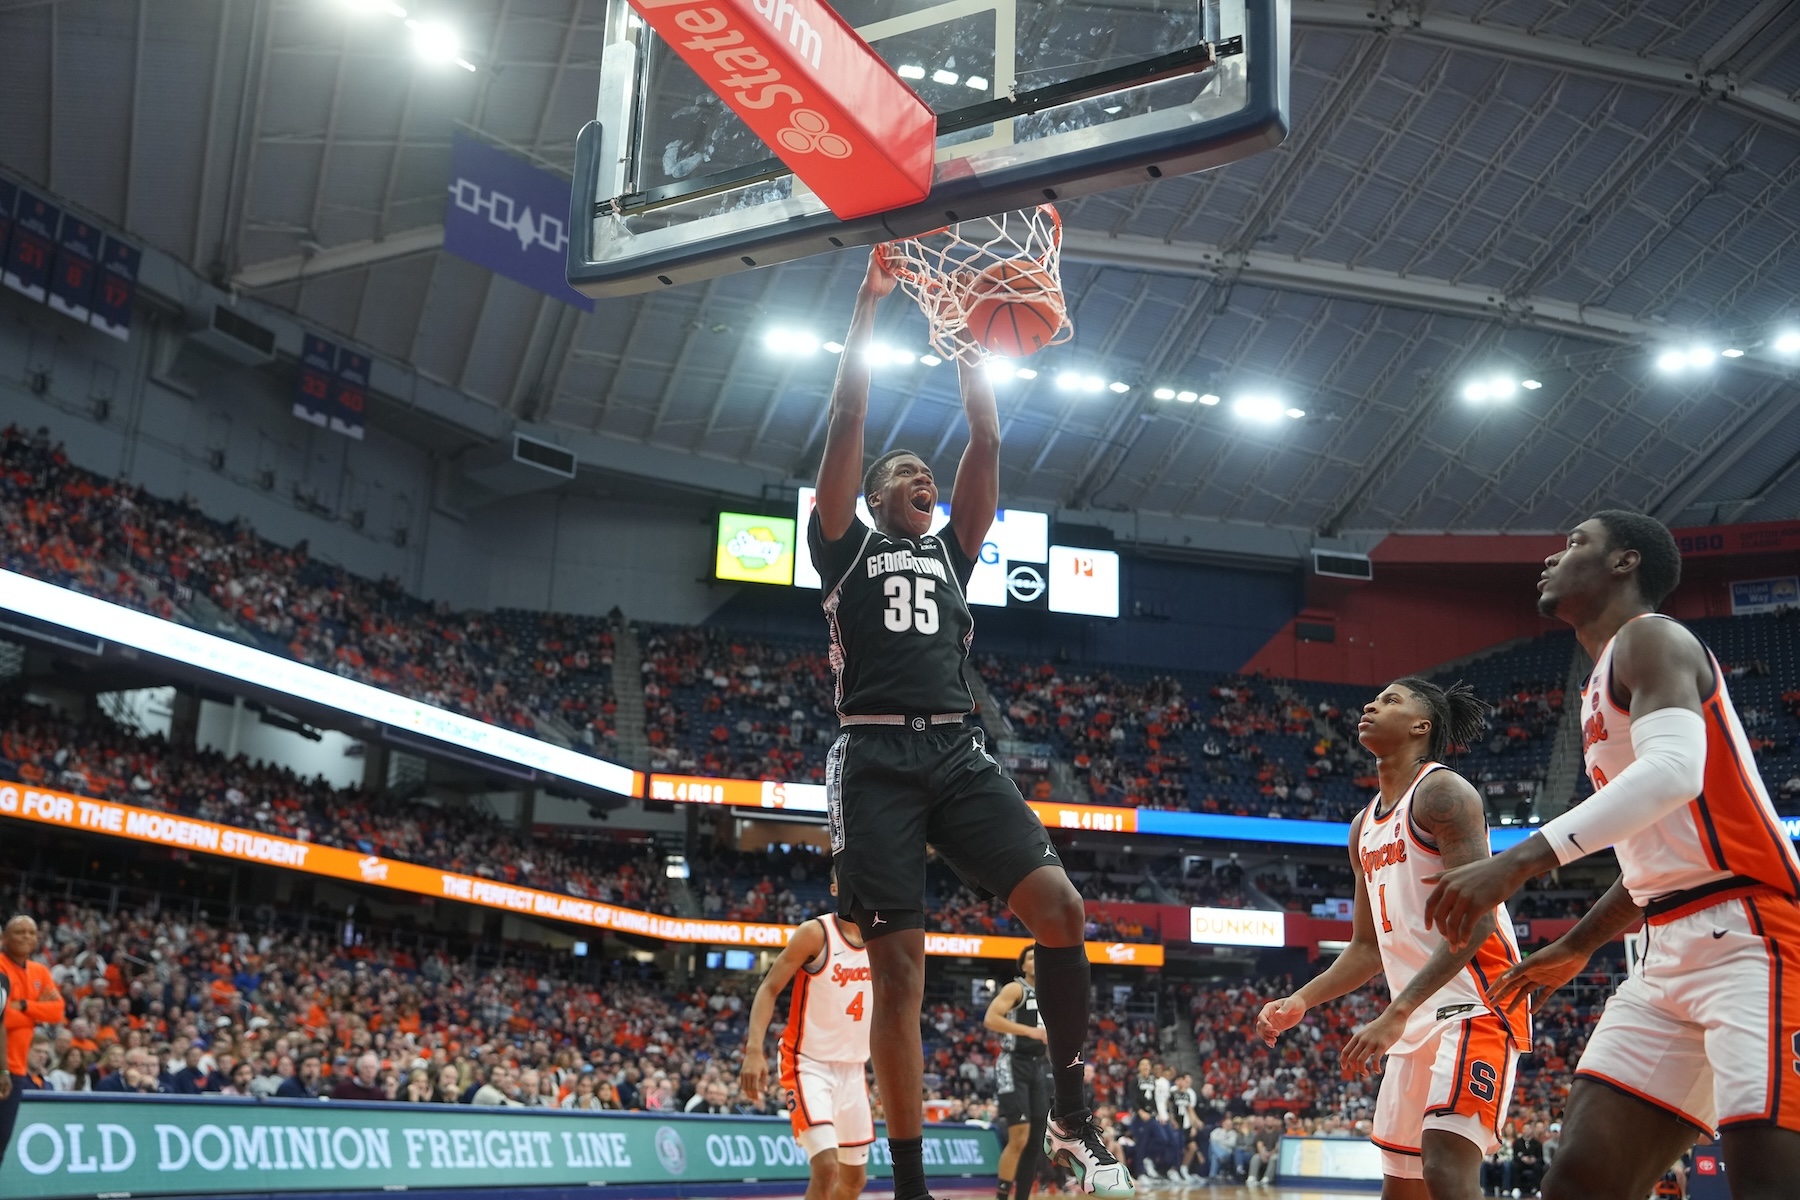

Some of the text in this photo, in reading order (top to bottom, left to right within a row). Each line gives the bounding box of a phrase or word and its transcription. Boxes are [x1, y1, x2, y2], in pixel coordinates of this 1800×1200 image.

[674, 7, 803, 110] State
[883, 575, 940, 635] 35
[1735, 583, 1769, 595] United
[1748, 594, 1770, 604] Way
[676, 782, 688, 800] 4
[22, 791, 73, 823] FOR
[78, 801, 124, 833] THE
[126, 812, 219, 850] MODERN
[220, 829, 309, 867] STUDENT
[1081, 812, 1090, 829] 4
[441, 874, 473, 900] THE
[471, 881, 535, 912] PERFECT
[534, 893, 593, 921] BALANCE
[593, 904, 613, 925] OF
[612, 909, 649, 932] LIVING
[658, 918, 742, 942] LEARNING
[743, 926, 783, 945] FOR
[1378, 884, 1393, 934] 1
[924, 936, 984, 955] UDENT
[831, 962, 872, 988] Syrac
[846, 991, 864, 1022] 4
[1468, 1059, 1498, 1104] S
[17, 1122, 632, 1175] OLD DOMINION FREIGHT LINE
[705, 1133, 757, 1168] OLD
[943, 1138, 985, 1166] LINE
